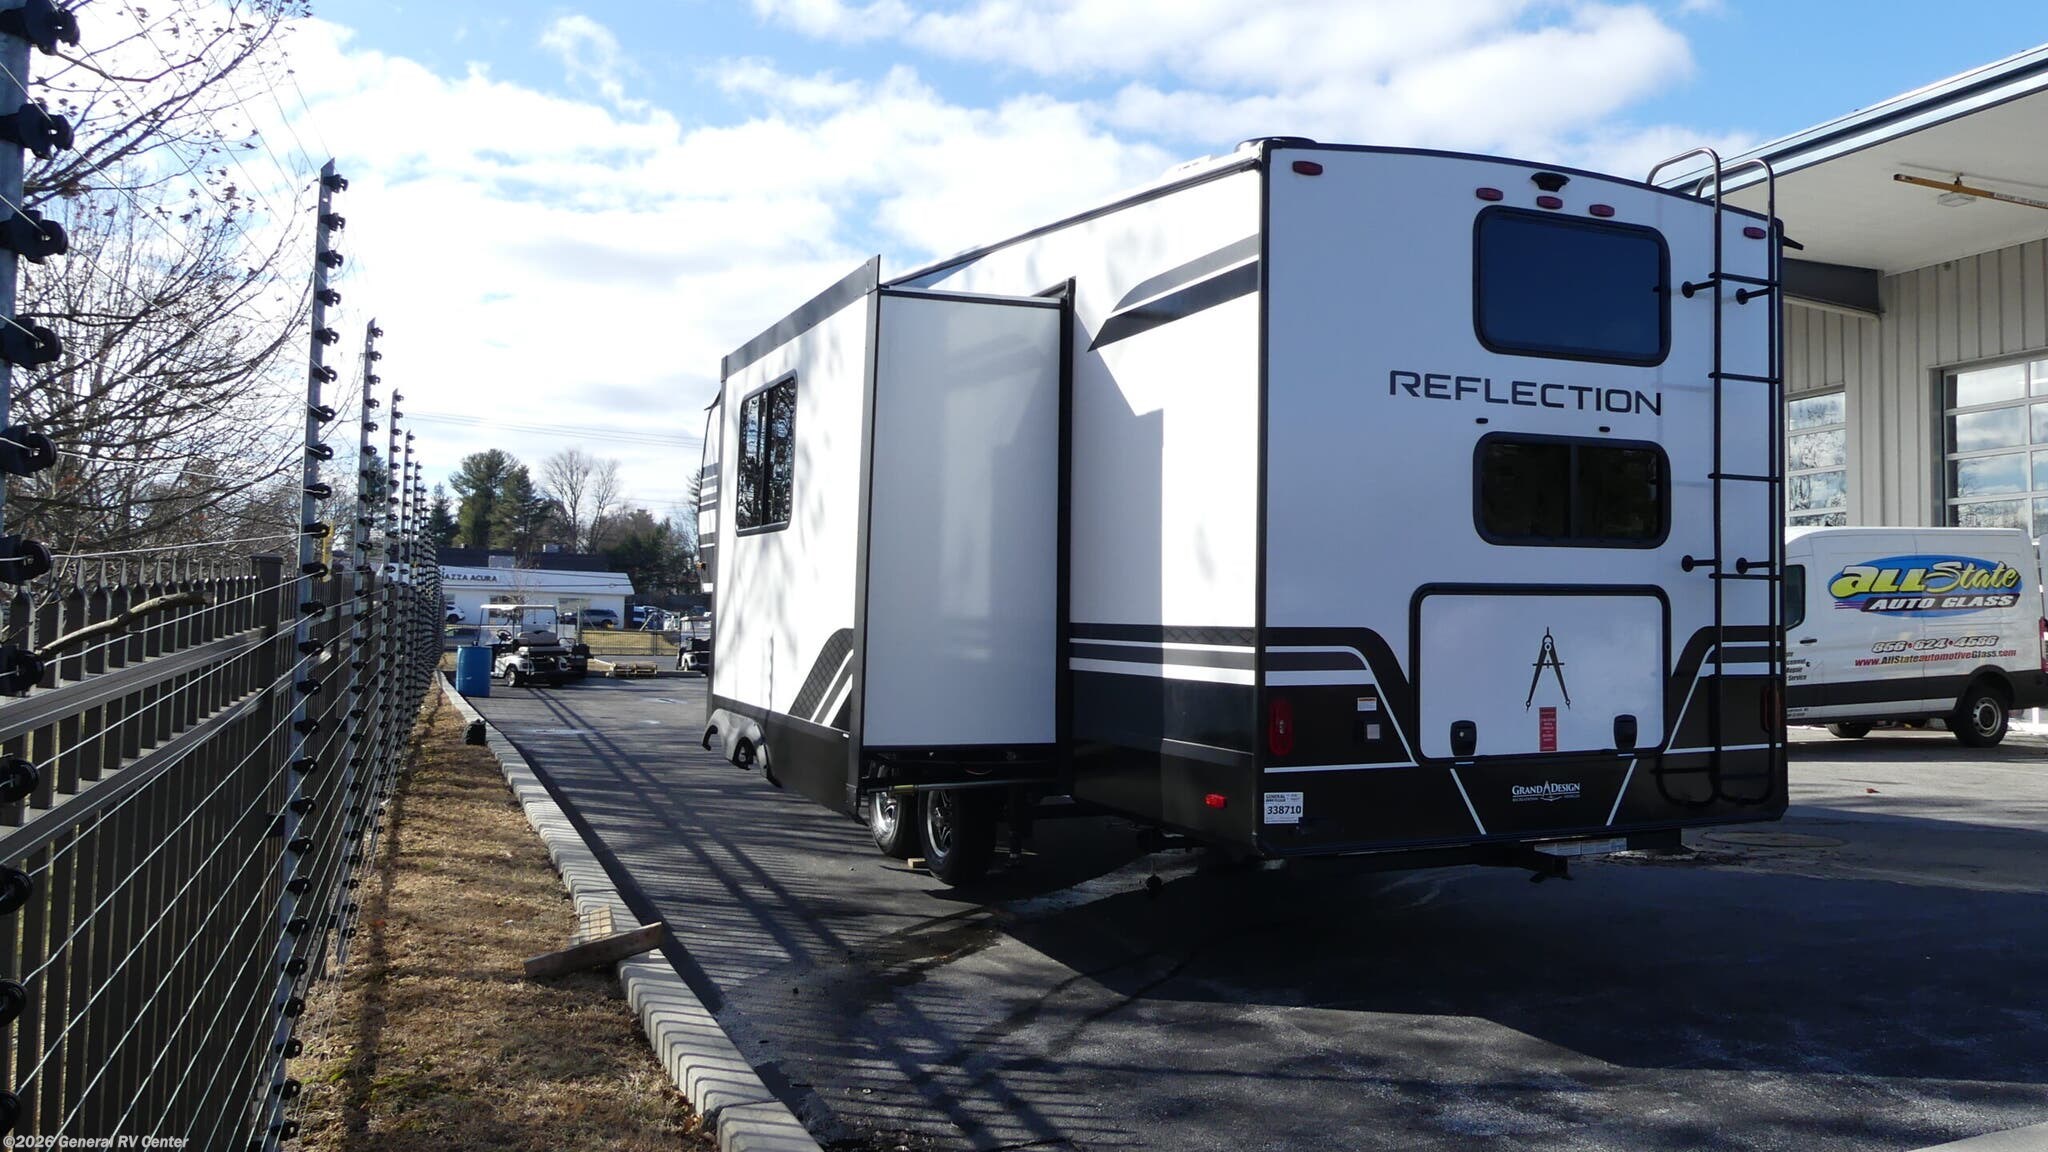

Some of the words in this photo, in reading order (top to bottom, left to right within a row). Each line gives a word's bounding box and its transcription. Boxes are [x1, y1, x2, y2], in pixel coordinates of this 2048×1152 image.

[1389, 370, 1661, 416] REFLECTION
[1869, 598, 1934, 610] AUTO
[1941, 595, 2015, 608] GLASS
[1512, 785, 1543, 795] GRAND
[1551, 783, 1580, 792] DESIGN
[1267, 805, 1302, 815] 338710
